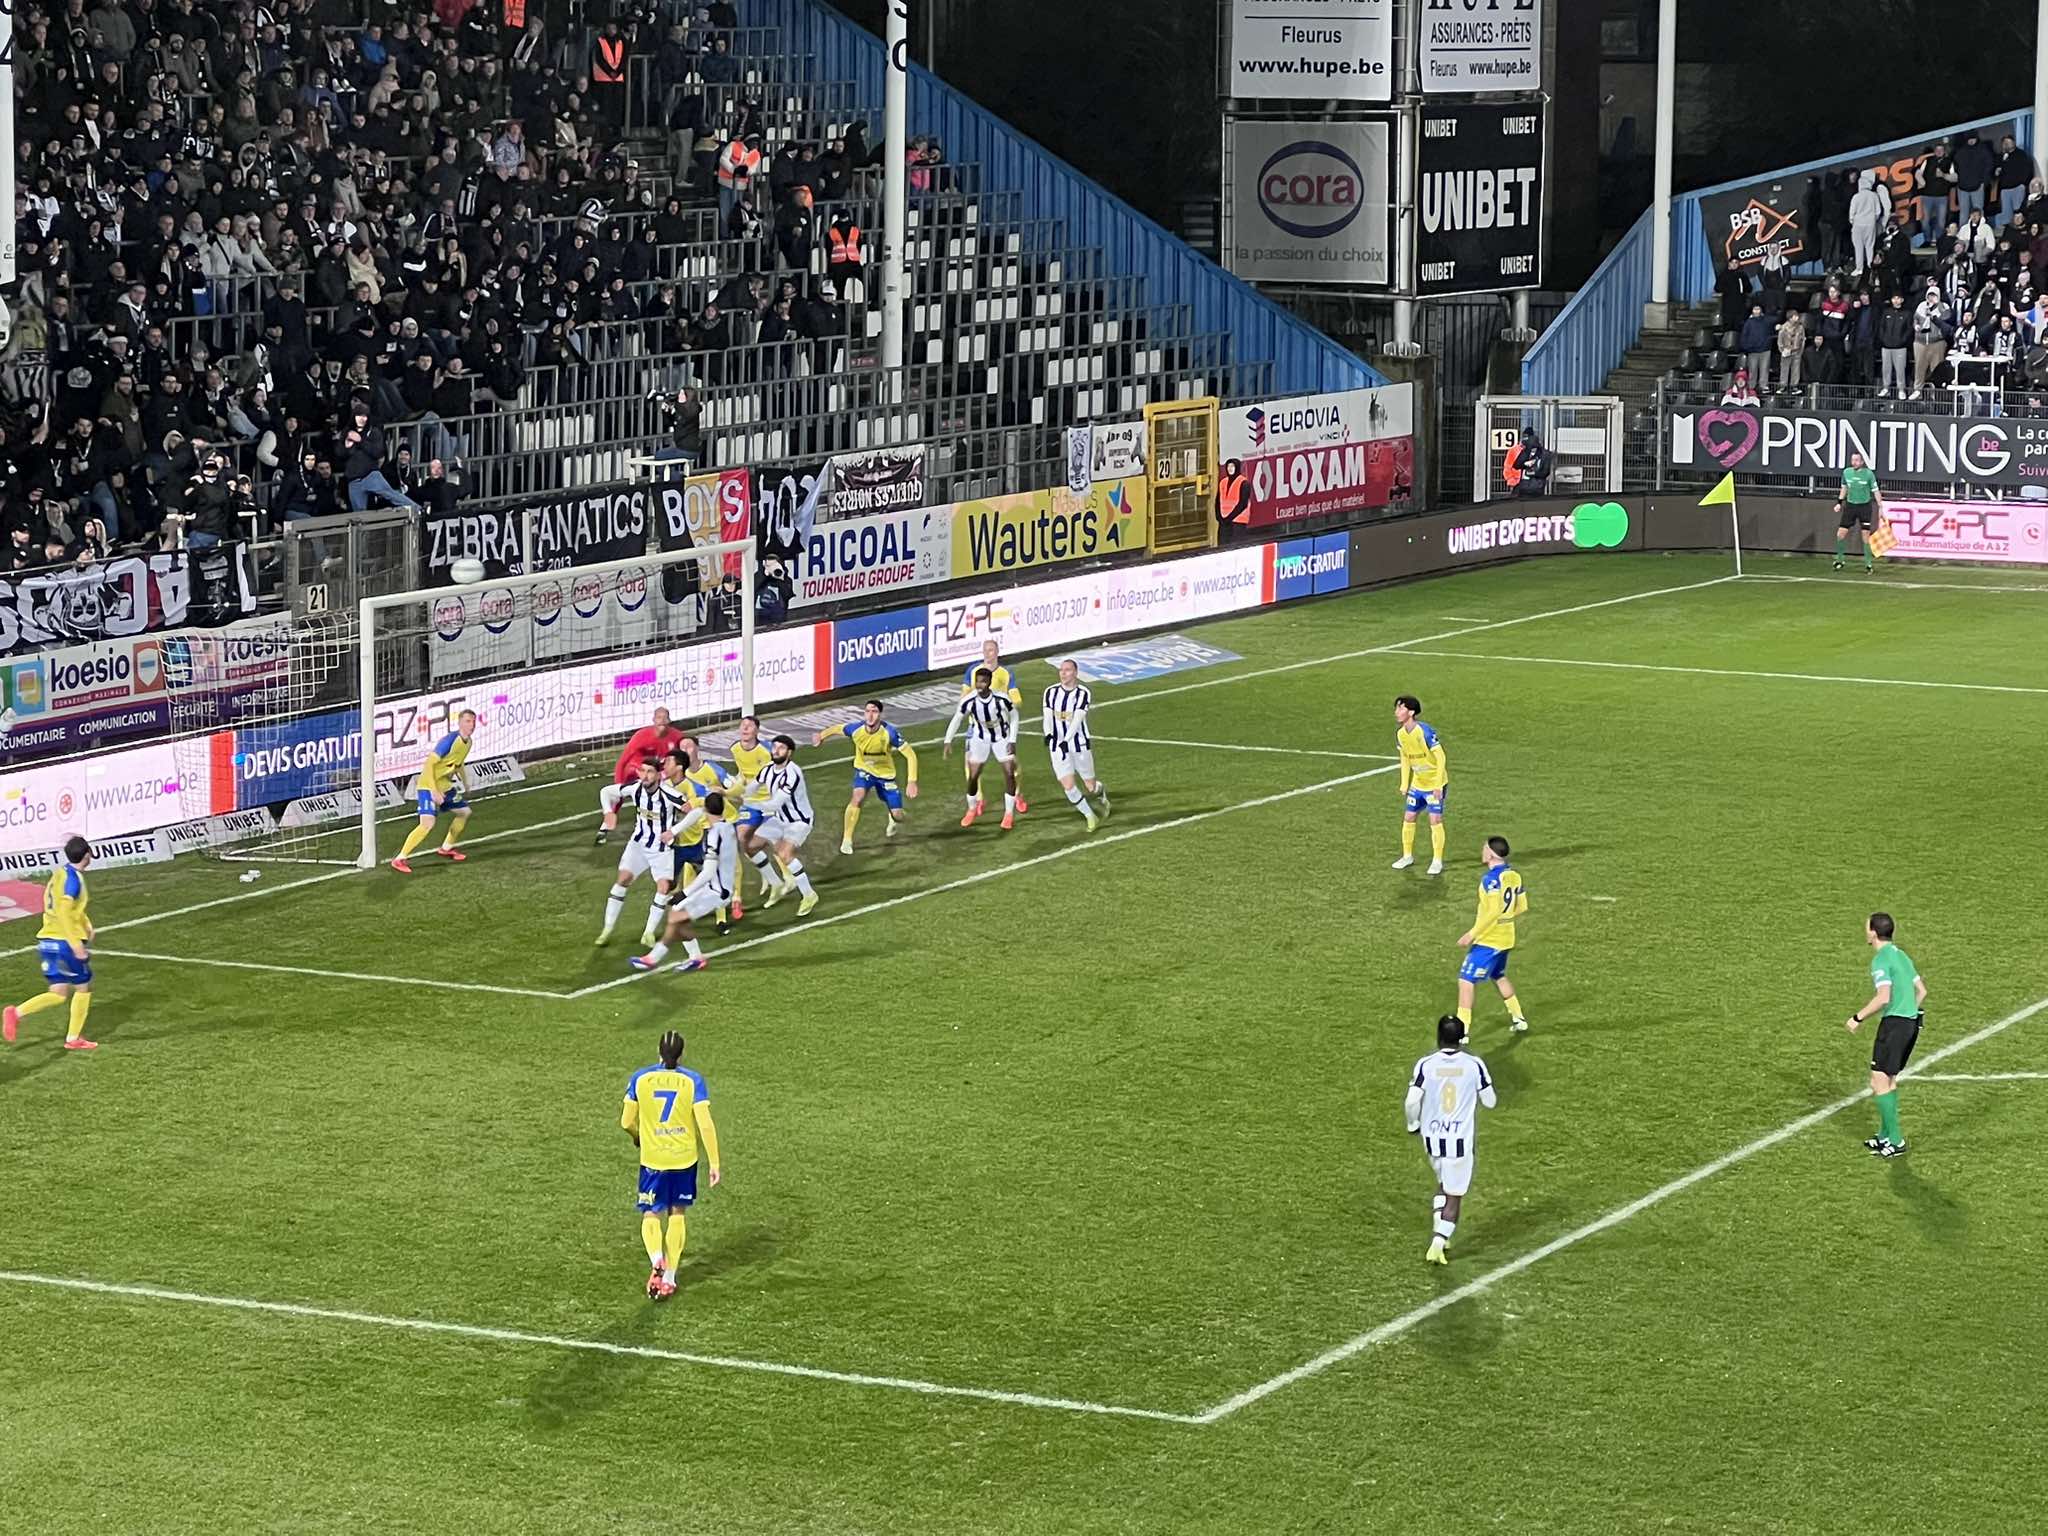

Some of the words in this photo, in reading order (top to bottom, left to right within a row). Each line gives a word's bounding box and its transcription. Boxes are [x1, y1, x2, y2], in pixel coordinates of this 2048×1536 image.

[1281, 25, 1342, 44] Fleurus
[1430, 22, 1493, 43] ASSURANCES
[1239, 57, 1384, 78] www.hupe.be
[1430, 60, 1457, 77] Fleurus
[1469, 58, 1532, 78] www.hupe.be
[1424, 119, 1458, 138] UNIBET
[1502, 116, 1537, 136] UNIBET
[1264, 174, 1355, 205] cora
[1423, 167, 1536, 233] UNIBET
[1729, 207, 1761, 231] BSB
[1235, 245, 1249, 260] la
[1253, 246, 1314, 262] passion
[1318, 247, 1338, 262] du
[1342, 247, 1384, 263] choix
[1738, 238, 1790, 259] CONSTCT
[1421, 261, 1456, 281] UNIBET
[1500, 254, 1534, 275] UNIBET
[1270, 405, 1341, 435] EUROVIA
[2016, 425, 2035, 440] La
[1494, 431, 1515, 448] 19
[1762, 415, 2011, 477] PRINTING
[1159, 460, 1171, 479] 20
[1275, 445, 1366, 500] LOXAM
[662, 479, 744, 537] BOYS
[426, 509, 520, 568] ZEBRA
[524, 490, 645, 557] FANATICS
[968, 509, 1098, 572] Wauters
[1448, 520, 1498, 554] UNIBET
[1498, 515, 1576, 546] EXPERTS
[1279, 555, 1306, 580] DEVIS
[1307, 549, 1347, 575] GRATUIT
[802, 570, 866, 599] TOURNEUR
[867, 563, 915, 589] GROUPE
[1193, 568, 1256, 596] www.azpc.be
[310, 585, 326, 610] 21
[1107, 583, 1174, 611] info@azpc.be
[838, 633, 873, 665] DEVIS
[873, 624, 926, 657] GRATUIT
[50, 647, 130, 692] koesio
[721, 651, 805, 685] ww.azpc.be
[613, 671, 697, 707] info@azpc.be
[498, 691, 585, 728] 0800/37.307
[78, 710, 157, 736] COMMUNICATION
[0, 727, 67, 752] CUMENTAIRE
[243, 745, 293, 780] DEVIS
[293, 731, 362, 768] GRATUIT
[474, 760, 513, 778] UNIBET
[85, 768, 198, 812] www.azpc.be
[299, 794, 339, 814] UNIBET
[166, 822, 210, 843] UNIBET
[223, 811, 266, 832] UNIBET
[90, 838, 156, 860] UNIBET
[653, 1090, 677, 1123] 7
